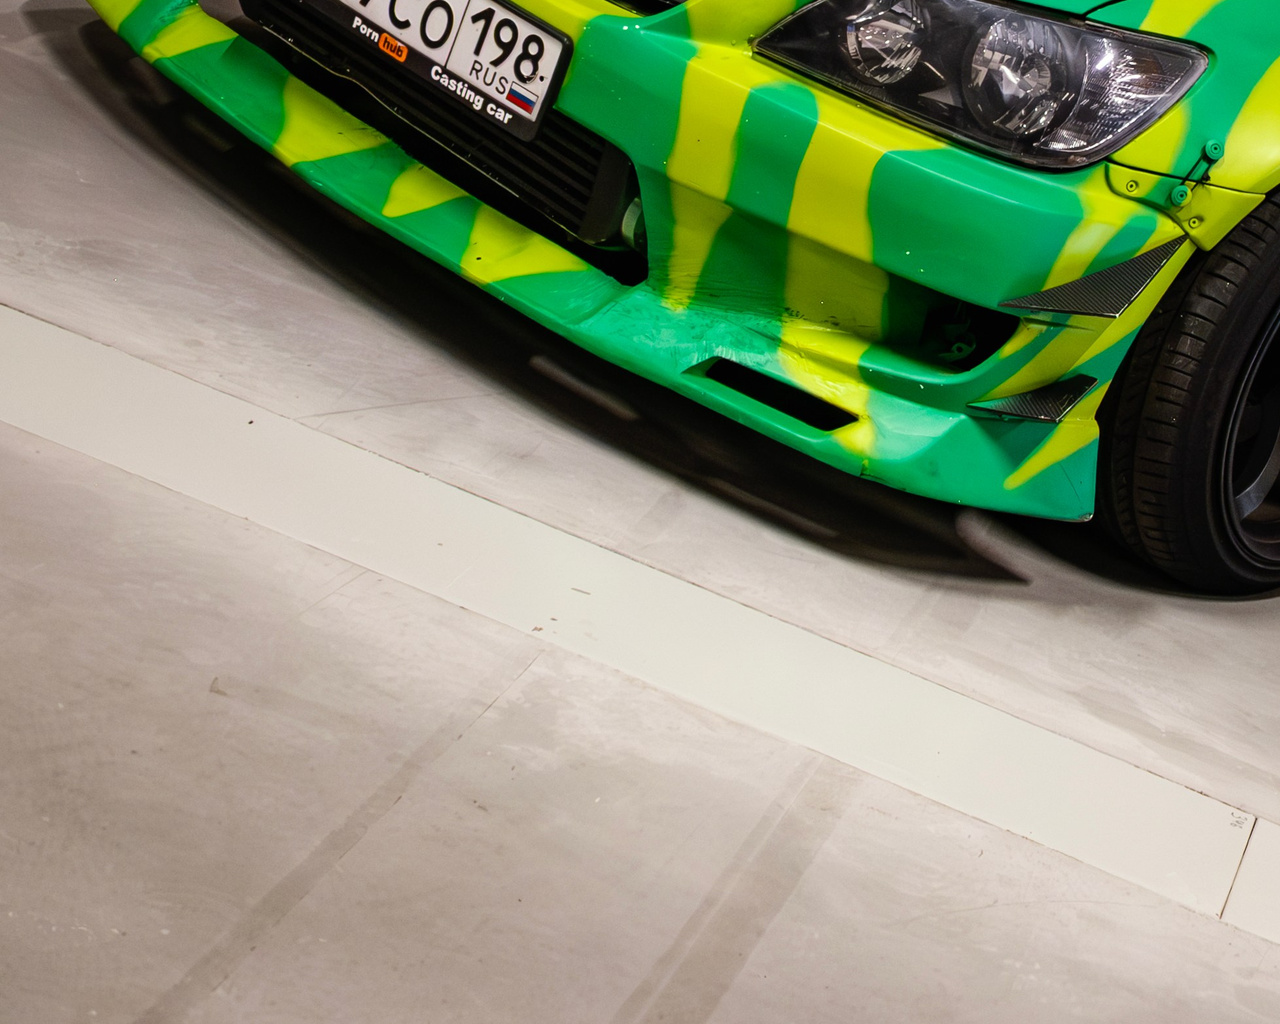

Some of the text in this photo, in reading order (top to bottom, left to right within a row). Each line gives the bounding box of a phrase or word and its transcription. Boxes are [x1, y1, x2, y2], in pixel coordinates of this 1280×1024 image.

[470, 7, 546, 85] 198
[430, 65, 513, 125] Casting car
[469, 59, 509, 96] RUS
